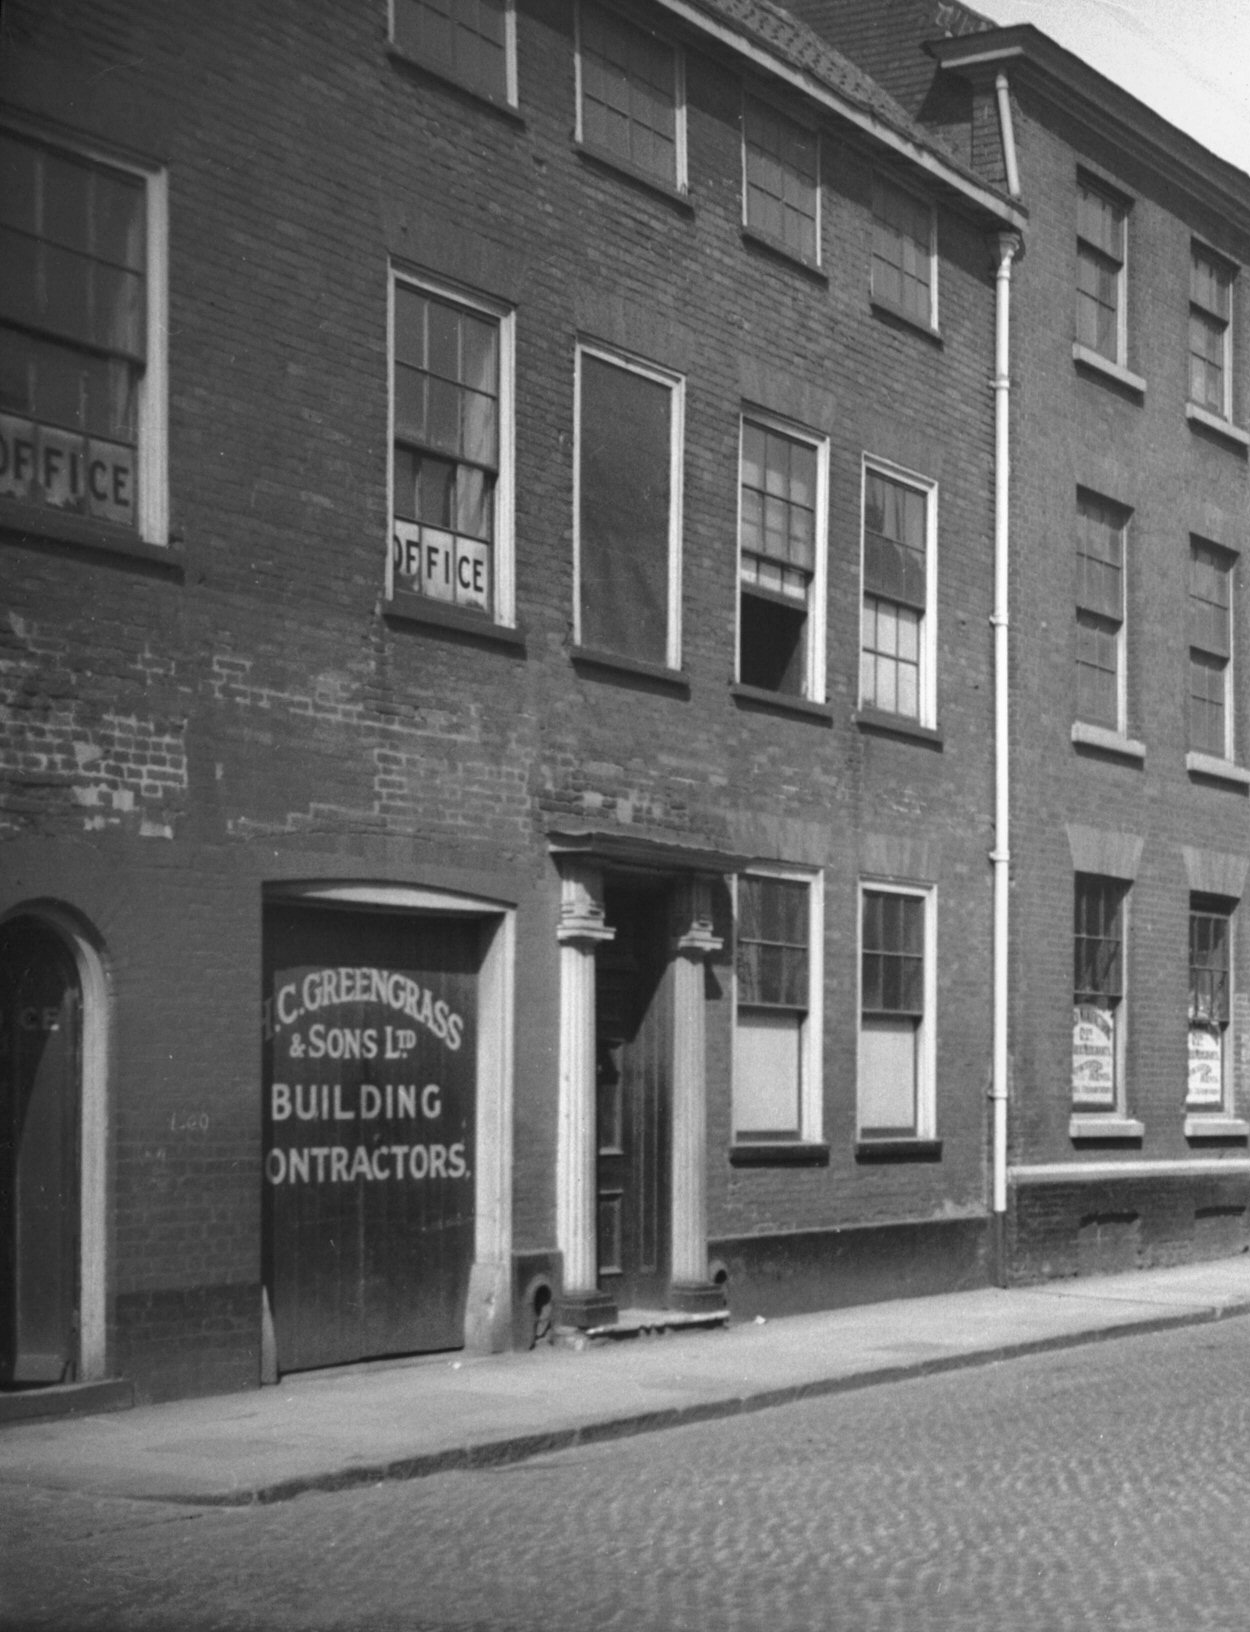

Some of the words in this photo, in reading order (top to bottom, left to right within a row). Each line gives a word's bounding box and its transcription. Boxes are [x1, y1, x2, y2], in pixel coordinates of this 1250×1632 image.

[302, 967, 464, 1050] GREENGRASS
[308, 1024, 378, 1059] SONS
[271, 1083, 442, 1121] BUILDING
